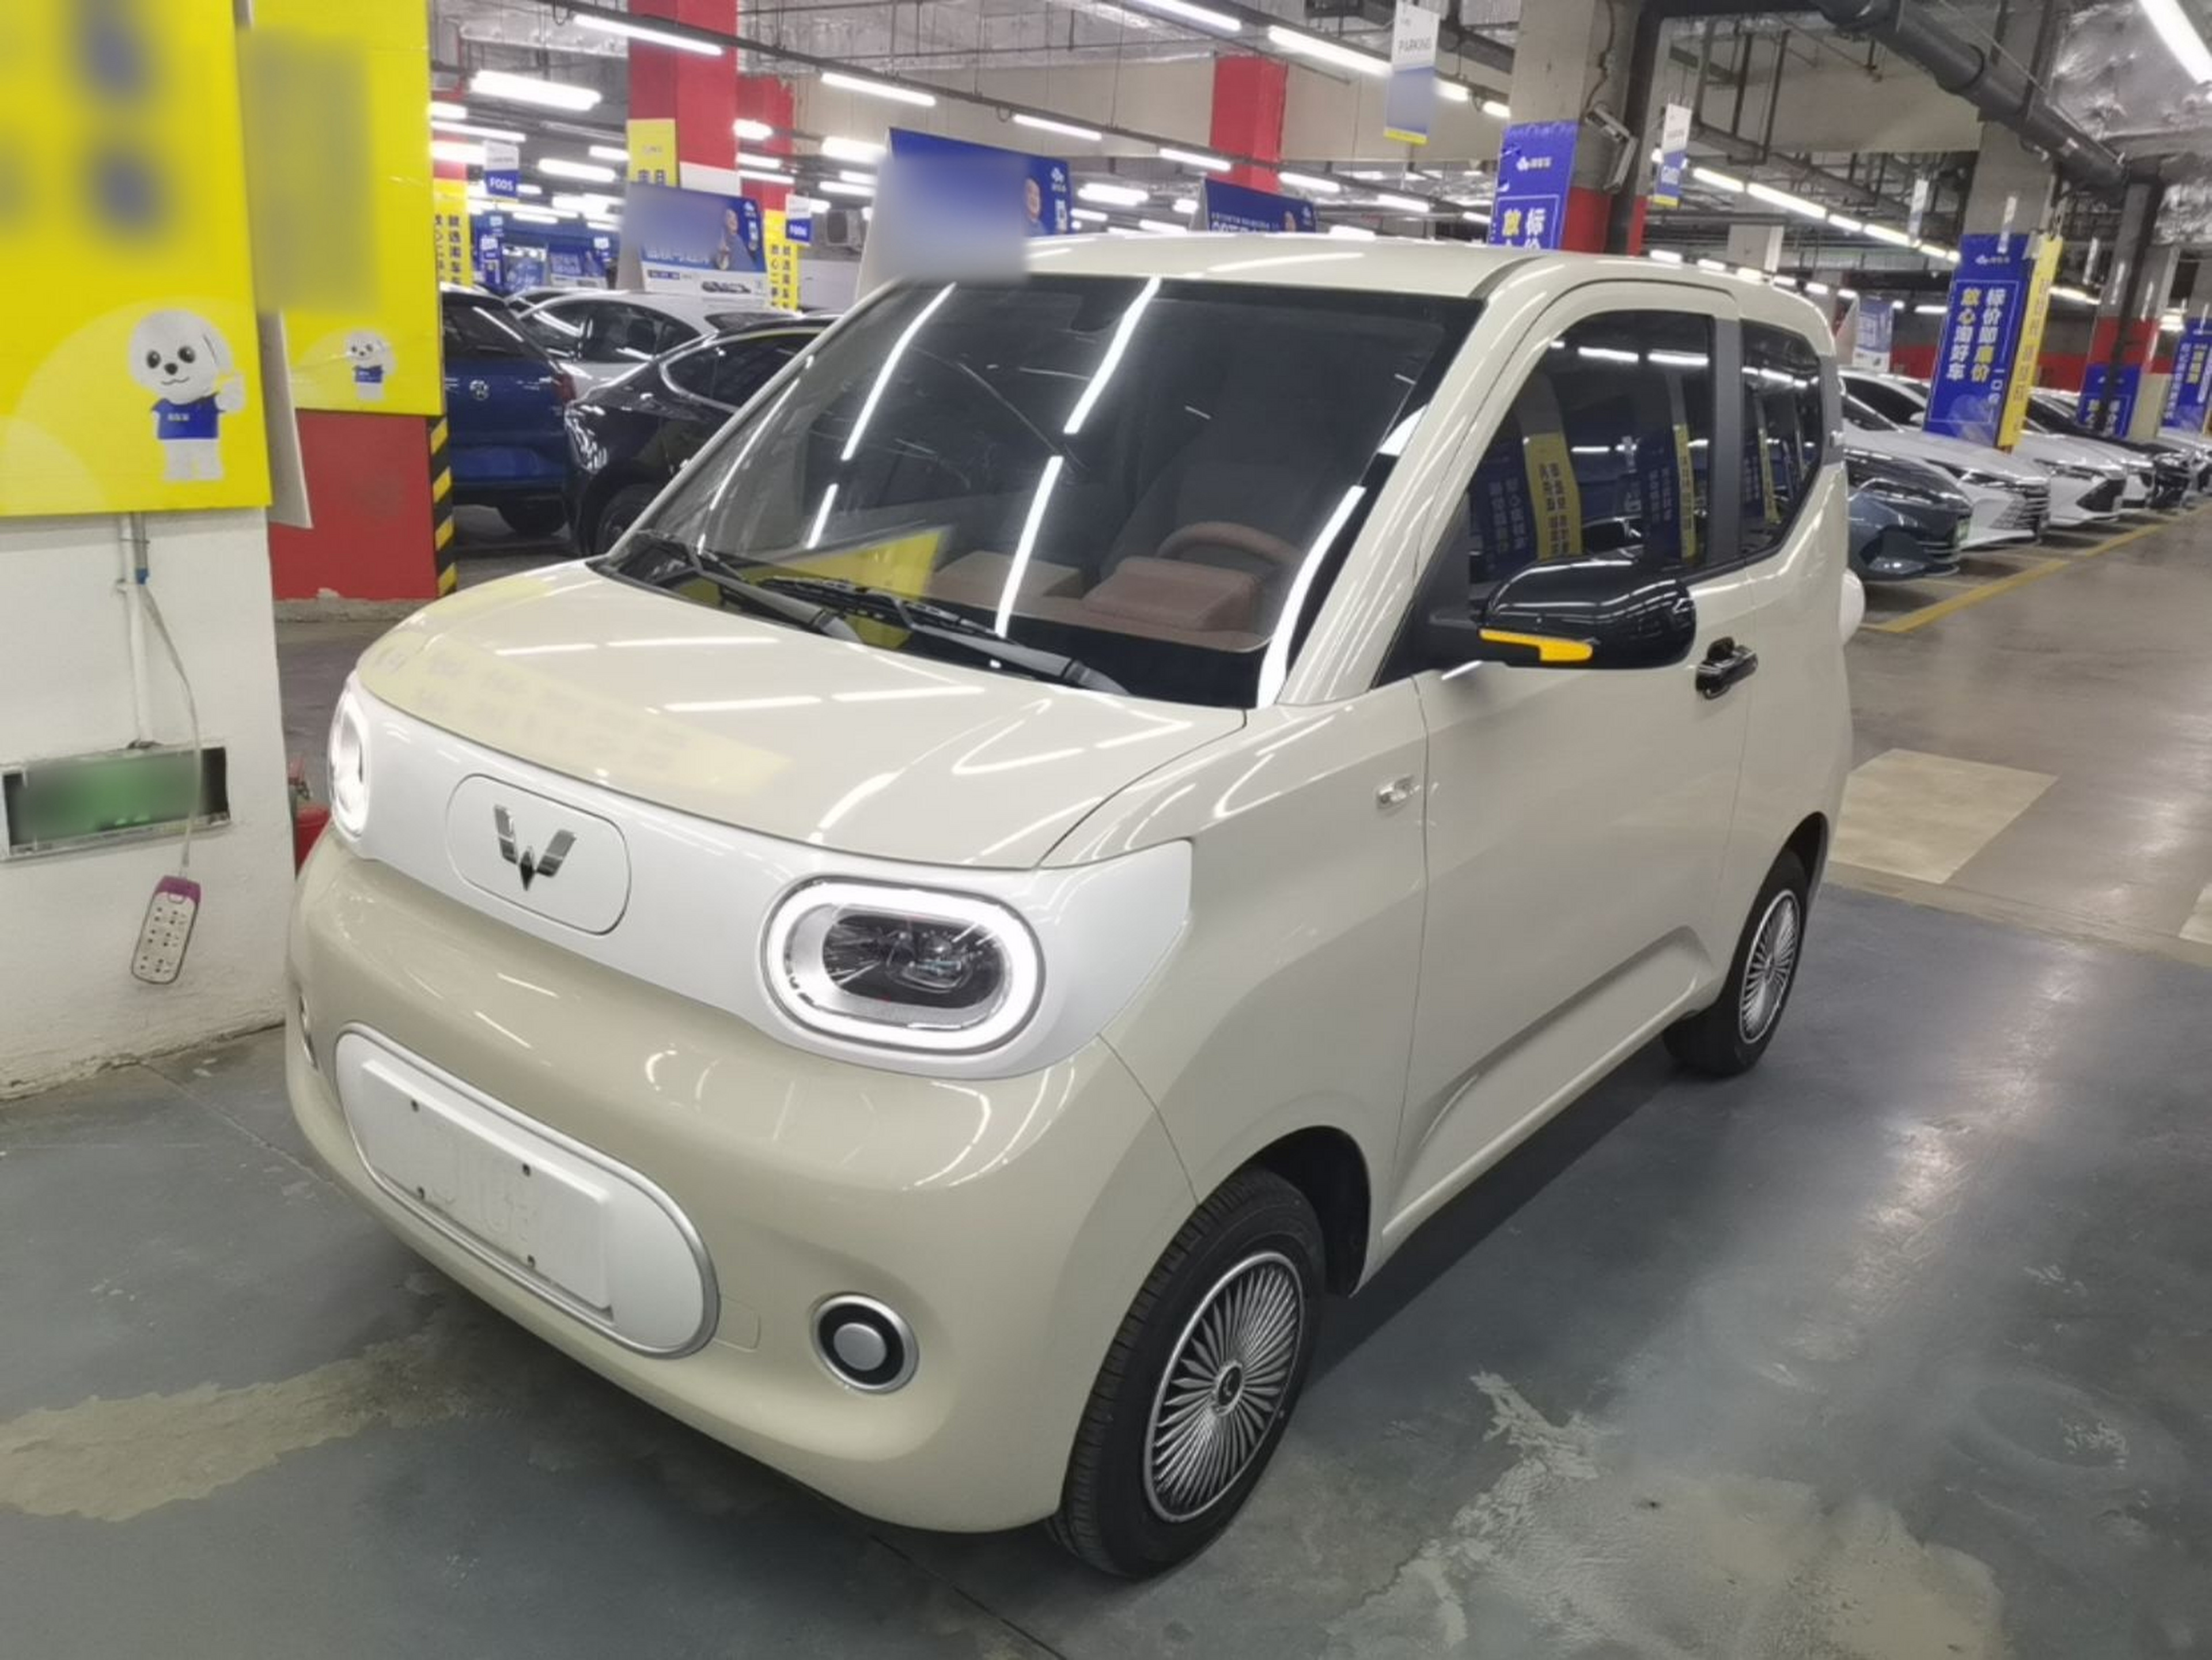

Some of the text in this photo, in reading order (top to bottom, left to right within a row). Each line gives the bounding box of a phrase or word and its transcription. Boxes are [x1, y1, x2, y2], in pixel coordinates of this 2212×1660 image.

[1947, 288, 1980, 380] 放心淘好车
